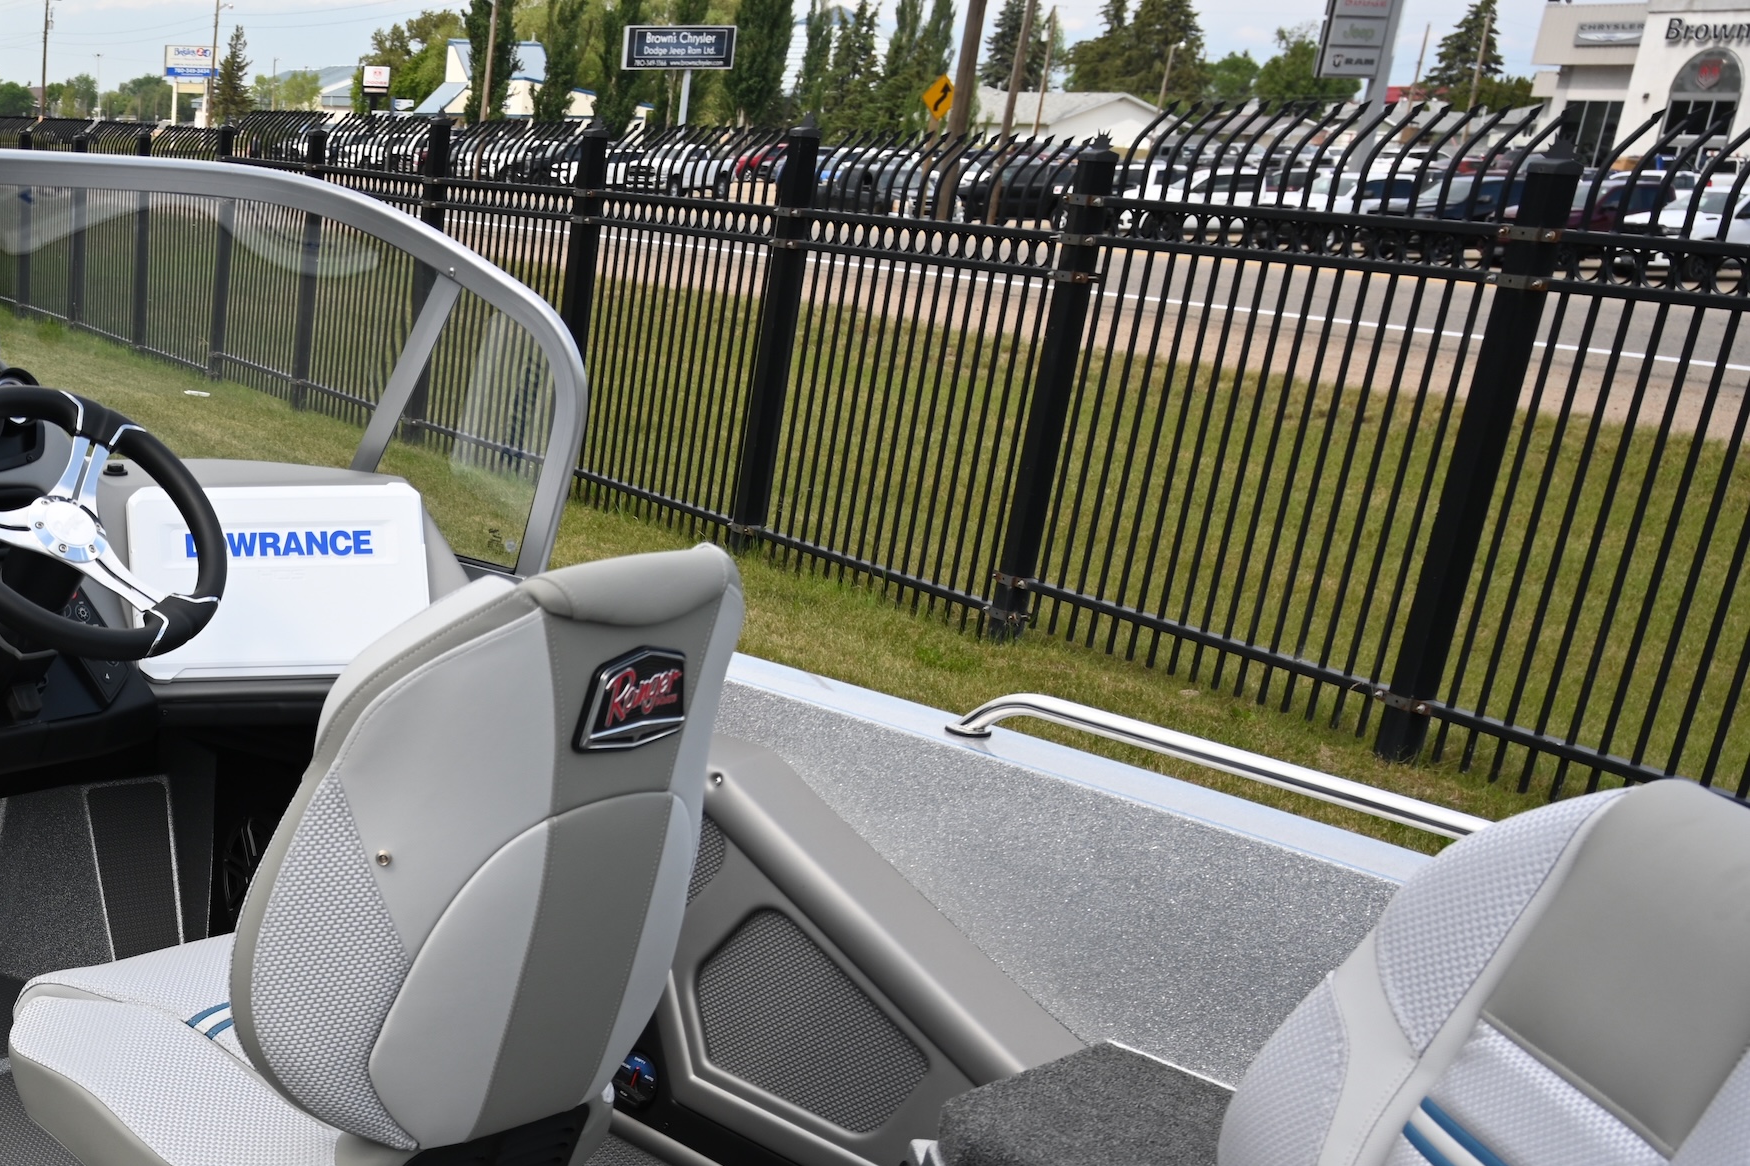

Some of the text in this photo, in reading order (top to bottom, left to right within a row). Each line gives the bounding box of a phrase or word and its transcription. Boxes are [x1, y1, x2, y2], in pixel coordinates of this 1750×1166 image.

[1343, 22, 1376, 42] Jeep
[1579, 23, 1645, 31] CHRYSLER
[645, 31, 717, 45] Brown's Chrysler
[643, 45, 717, 56] Dodge Jeep Ram Ltd.
[1344, 58, 1375, 66] RAM
[185, 530, 374, 559] LWRANCE
[604, 667, 683, 728] Ranger
